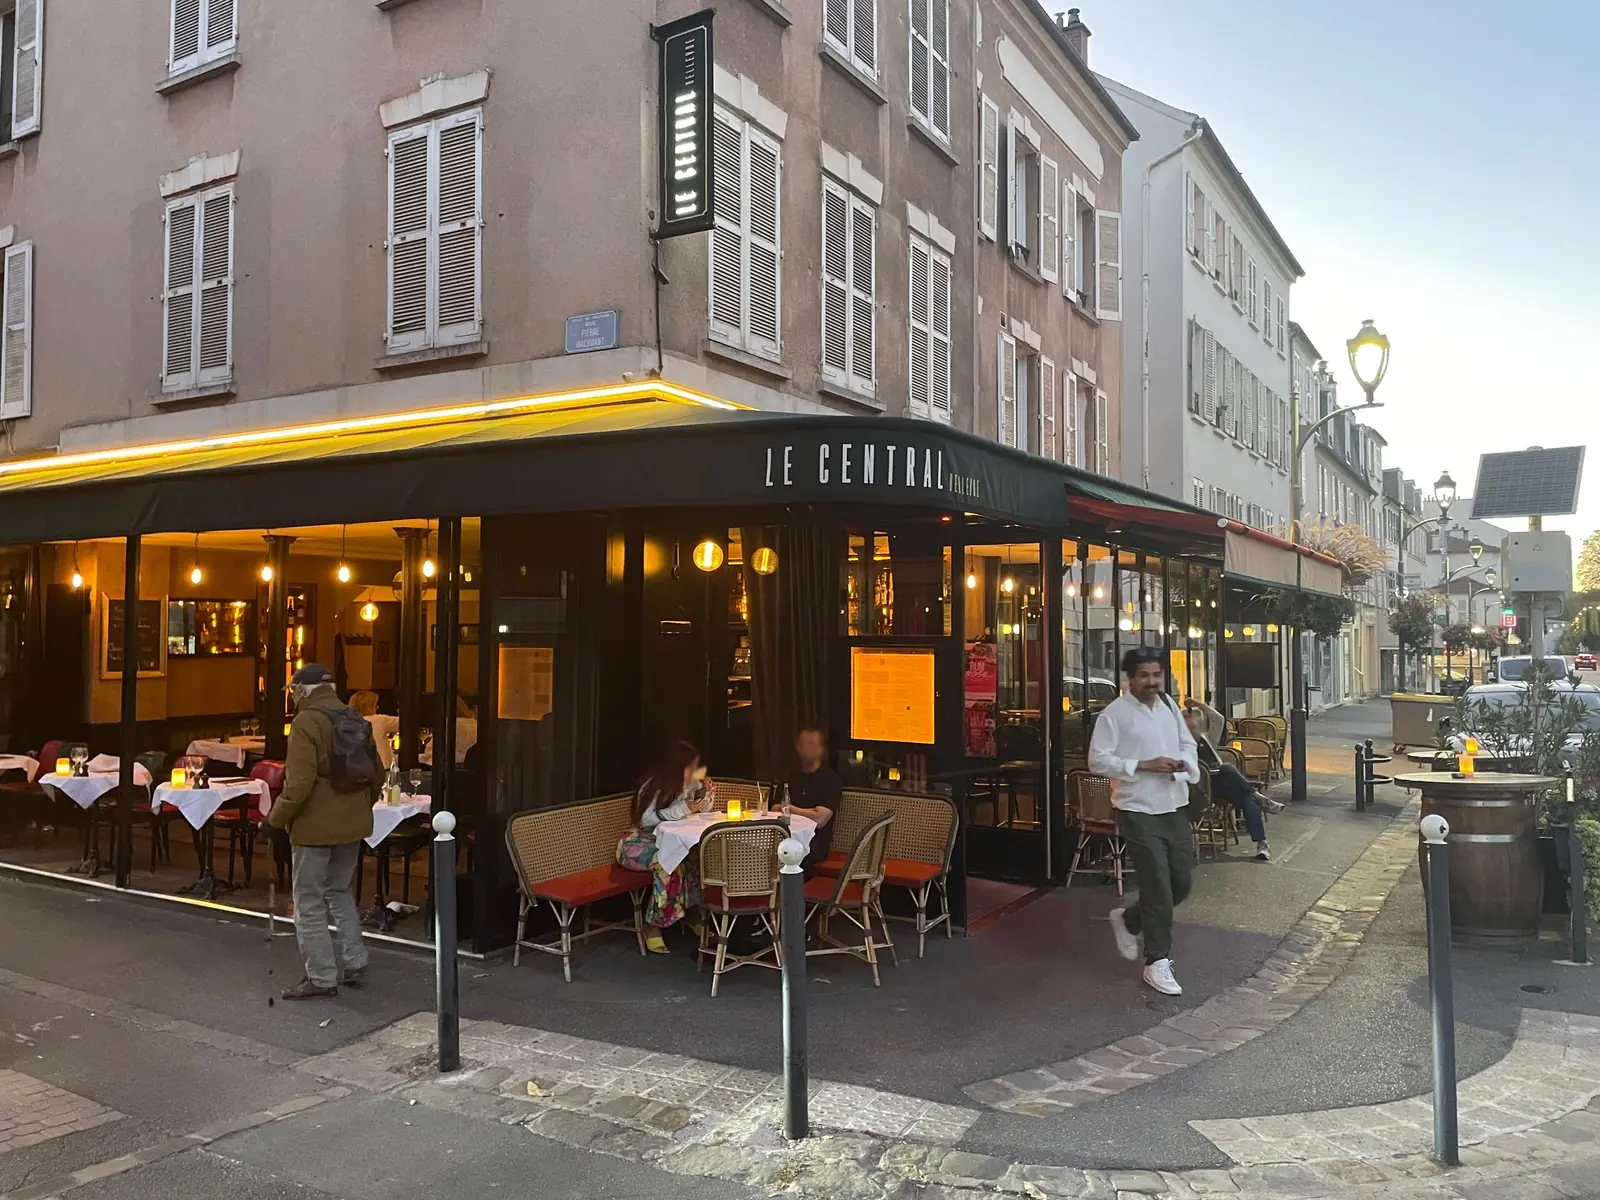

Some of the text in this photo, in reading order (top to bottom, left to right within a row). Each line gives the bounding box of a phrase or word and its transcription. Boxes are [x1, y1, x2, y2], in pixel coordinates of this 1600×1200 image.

[675, 90, 697, 180] CENTRAL
[675, 190, 697, 215] LE
[765, 446, 793, 486] LE
[819, 443, 943, 489] CENTRAL
